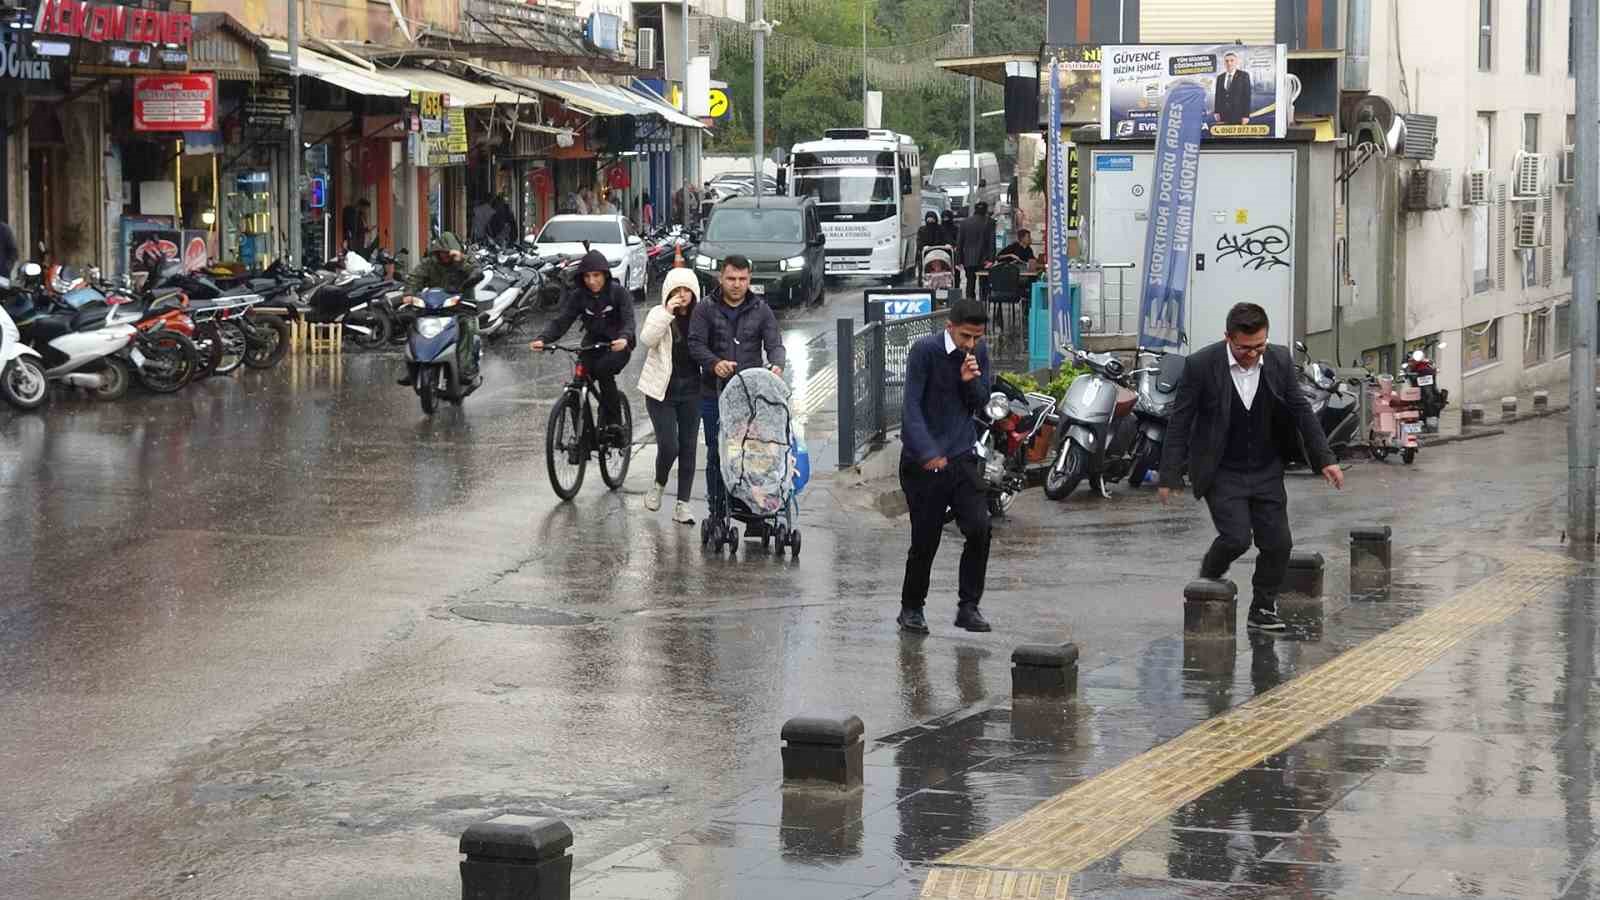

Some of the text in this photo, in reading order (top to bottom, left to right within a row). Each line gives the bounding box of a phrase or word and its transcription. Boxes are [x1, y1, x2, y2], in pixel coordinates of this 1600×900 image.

[1113, 50, 1160, 64] GÜVENCE
[1149, 102, 1183, 286] SİGORTADA DOĞRU ADRES
[1173, 142, 1198, 252] EVRAN SİGORTA
